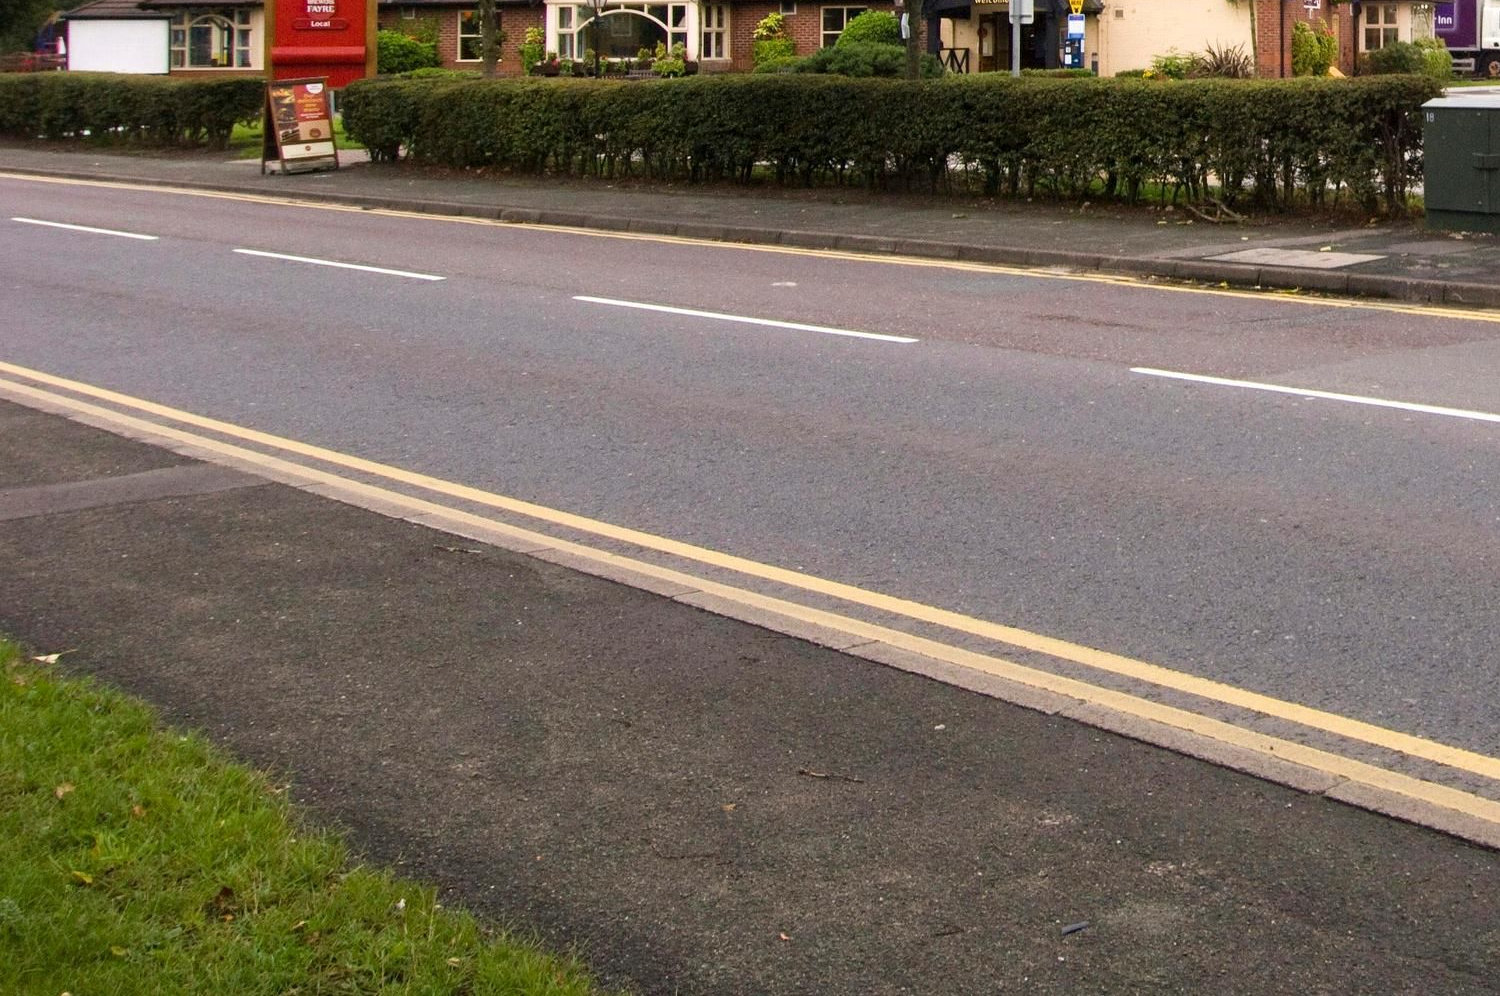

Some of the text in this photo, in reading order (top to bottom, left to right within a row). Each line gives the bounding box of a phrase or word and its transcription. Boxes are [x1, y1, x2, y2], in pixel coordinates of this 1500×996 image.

[307, 5, 335, 13] FAYRE
[1438, 15, 1453, 25] Inn
[1426, 111, 1435, 123] 18
